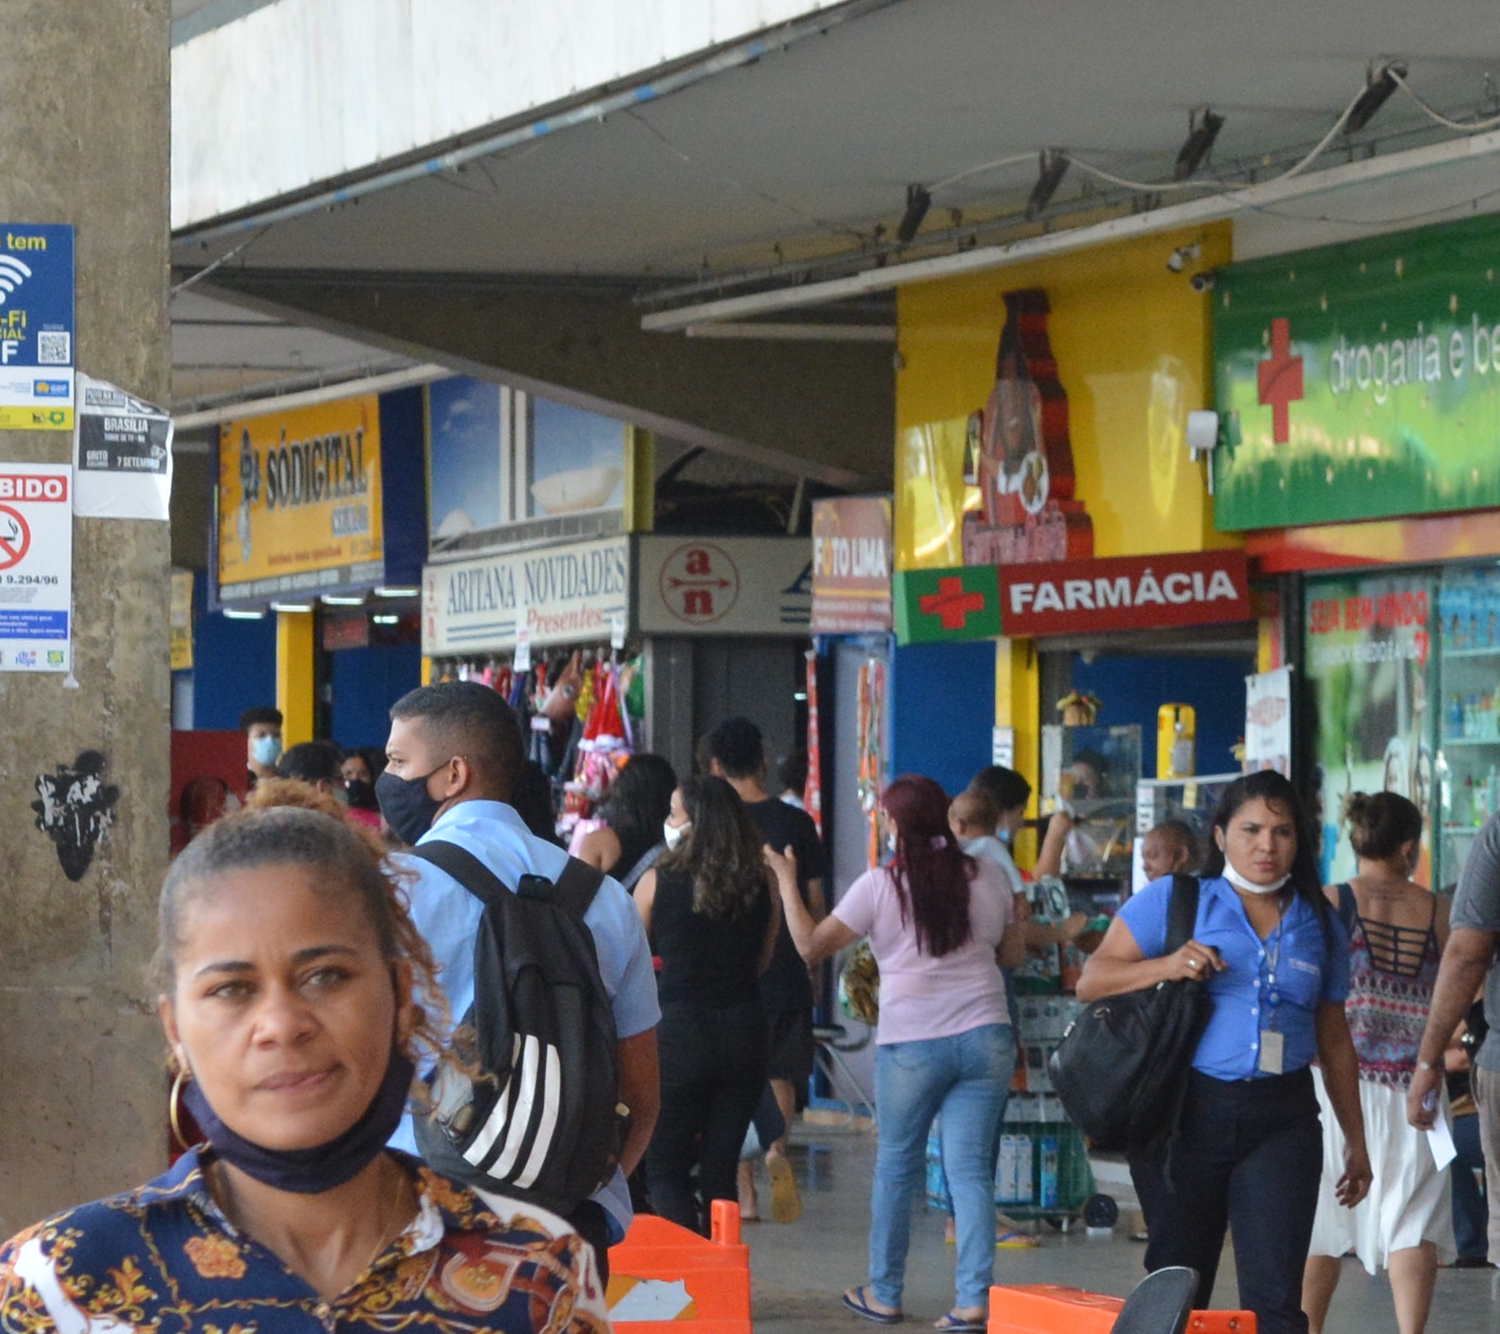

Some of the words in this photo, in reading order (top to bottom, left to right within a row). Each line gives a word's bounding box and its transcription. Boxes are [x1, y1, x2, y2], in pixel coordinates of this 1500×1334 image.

[7, 233, 47, 251] tem
[1329, 320, 1441, 405] drogaria
[1449, 330, 1465, 378] e
[104, 416, 149, 433] BRASÍLIA
[266, 424, 368, 513] SÓDIGITAL
[814, 536, 849, 576] FOTO
[851, 536, 888, 577] LIMA
[6, 575, 59, 585] 9.294/96
[447, 565, 516, 615] ARITANA
[523, 546, 627, 606] NOVIDADES
[1010, 569, 1238, 613] FARMÁCIA
[526, 603, 604, 634] Presentes
